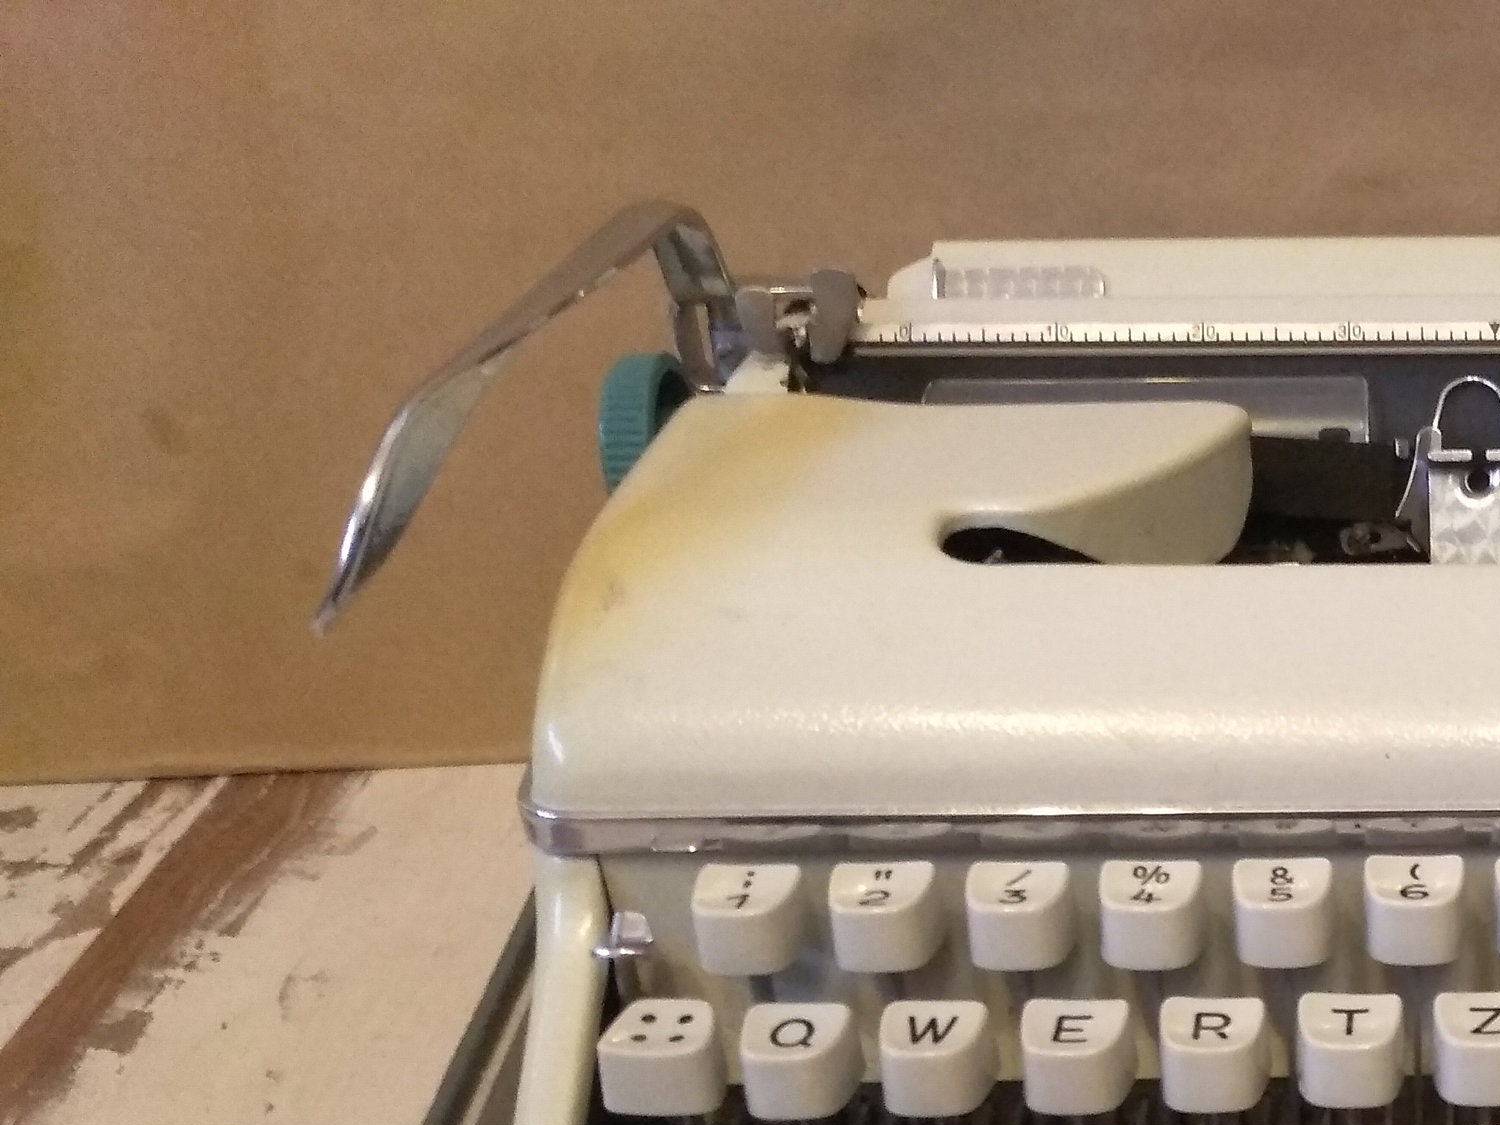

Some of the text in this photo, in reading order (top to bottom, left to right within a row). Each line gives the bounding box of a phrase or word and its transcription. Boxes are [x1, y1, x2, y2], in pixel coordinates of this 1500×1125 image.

[1338, 324, 1362, 339] 30
[859, 890, 890, 906] 2
[999, 889, 1027, 905] 3
[1130, 888, 1160, 904] 4
[1268, 886, 1293, 902] 5
[1400, 883, 1429, 900] 6
[908, 1015, 959, 1045] W
[1051, 1015, 1093, 1044] E
[1191, 1012, 1232, 1041] R
[1331, 1008, 1370, 1036] T
[769, 1018, 815, 1048] Q
